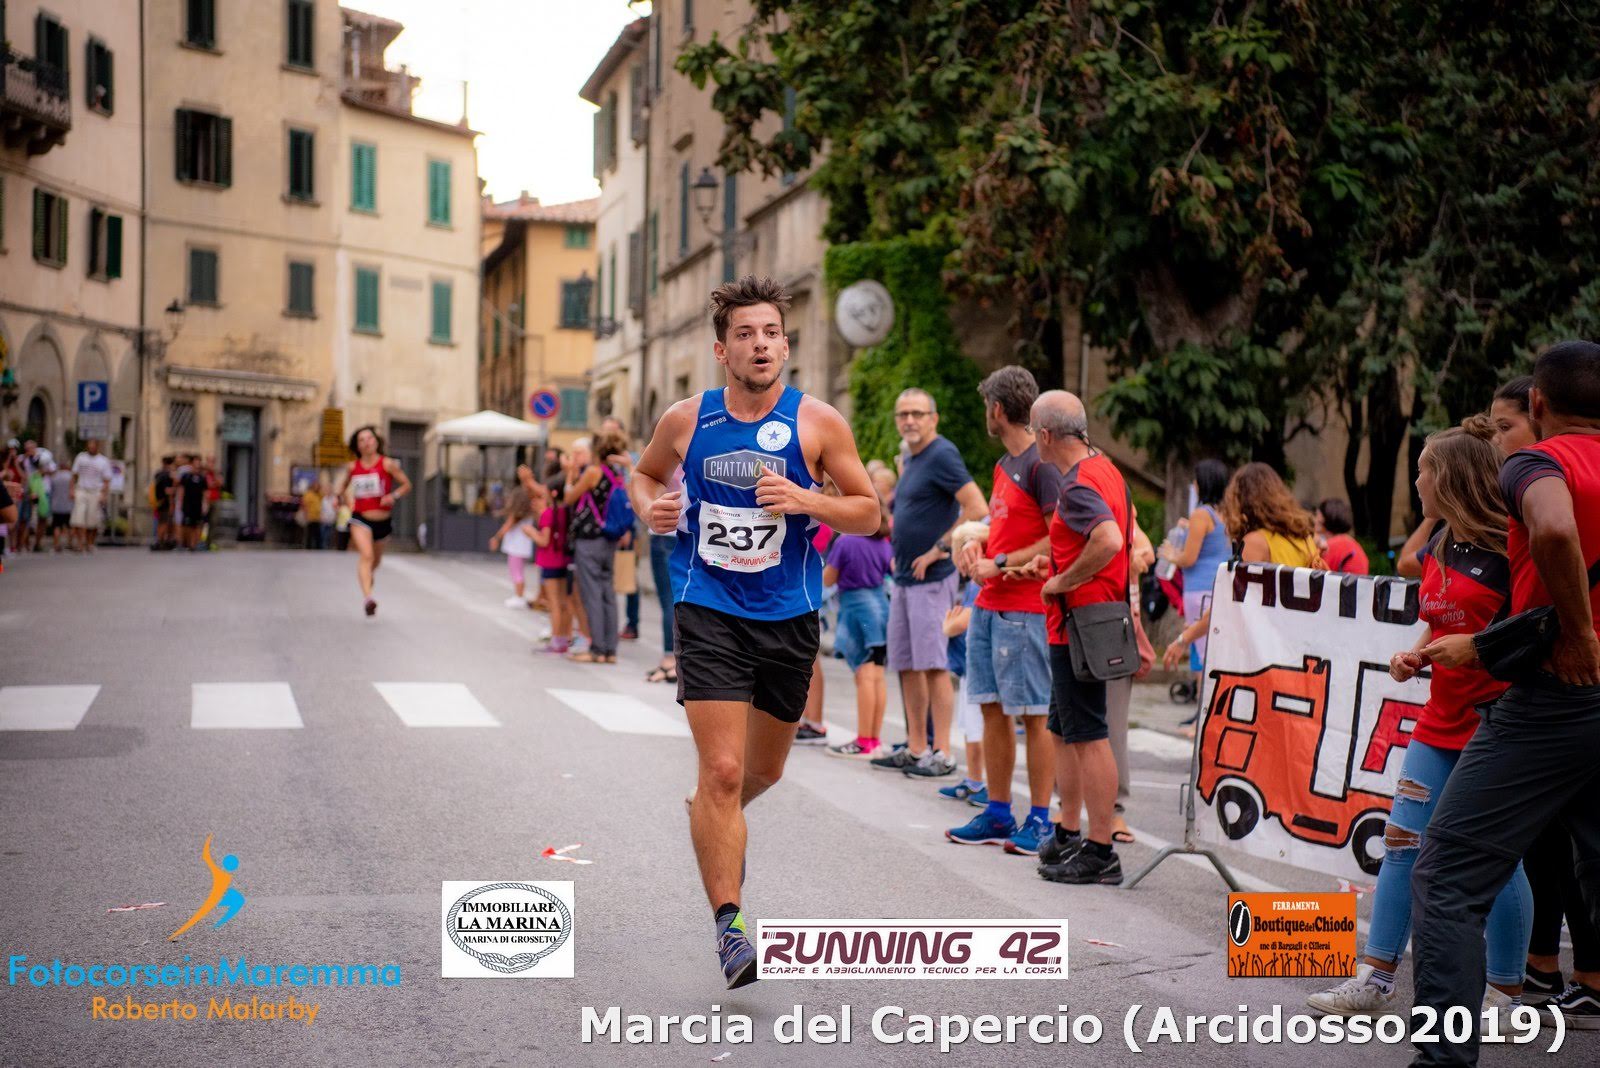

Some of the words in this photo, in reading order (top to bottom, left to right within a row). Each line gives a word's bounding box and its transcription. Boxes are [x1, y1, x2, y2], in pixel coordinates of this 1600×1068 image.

[83, 383, 102, 411] P
[710, 458, 778, 478] CHATTANOGA
[707, 522, 778, 551] 237
[730, 554, 767, 567] RUNNING
[768, 551, 779, 560] 42
[1232, 562, 1421, 625] AUTO
